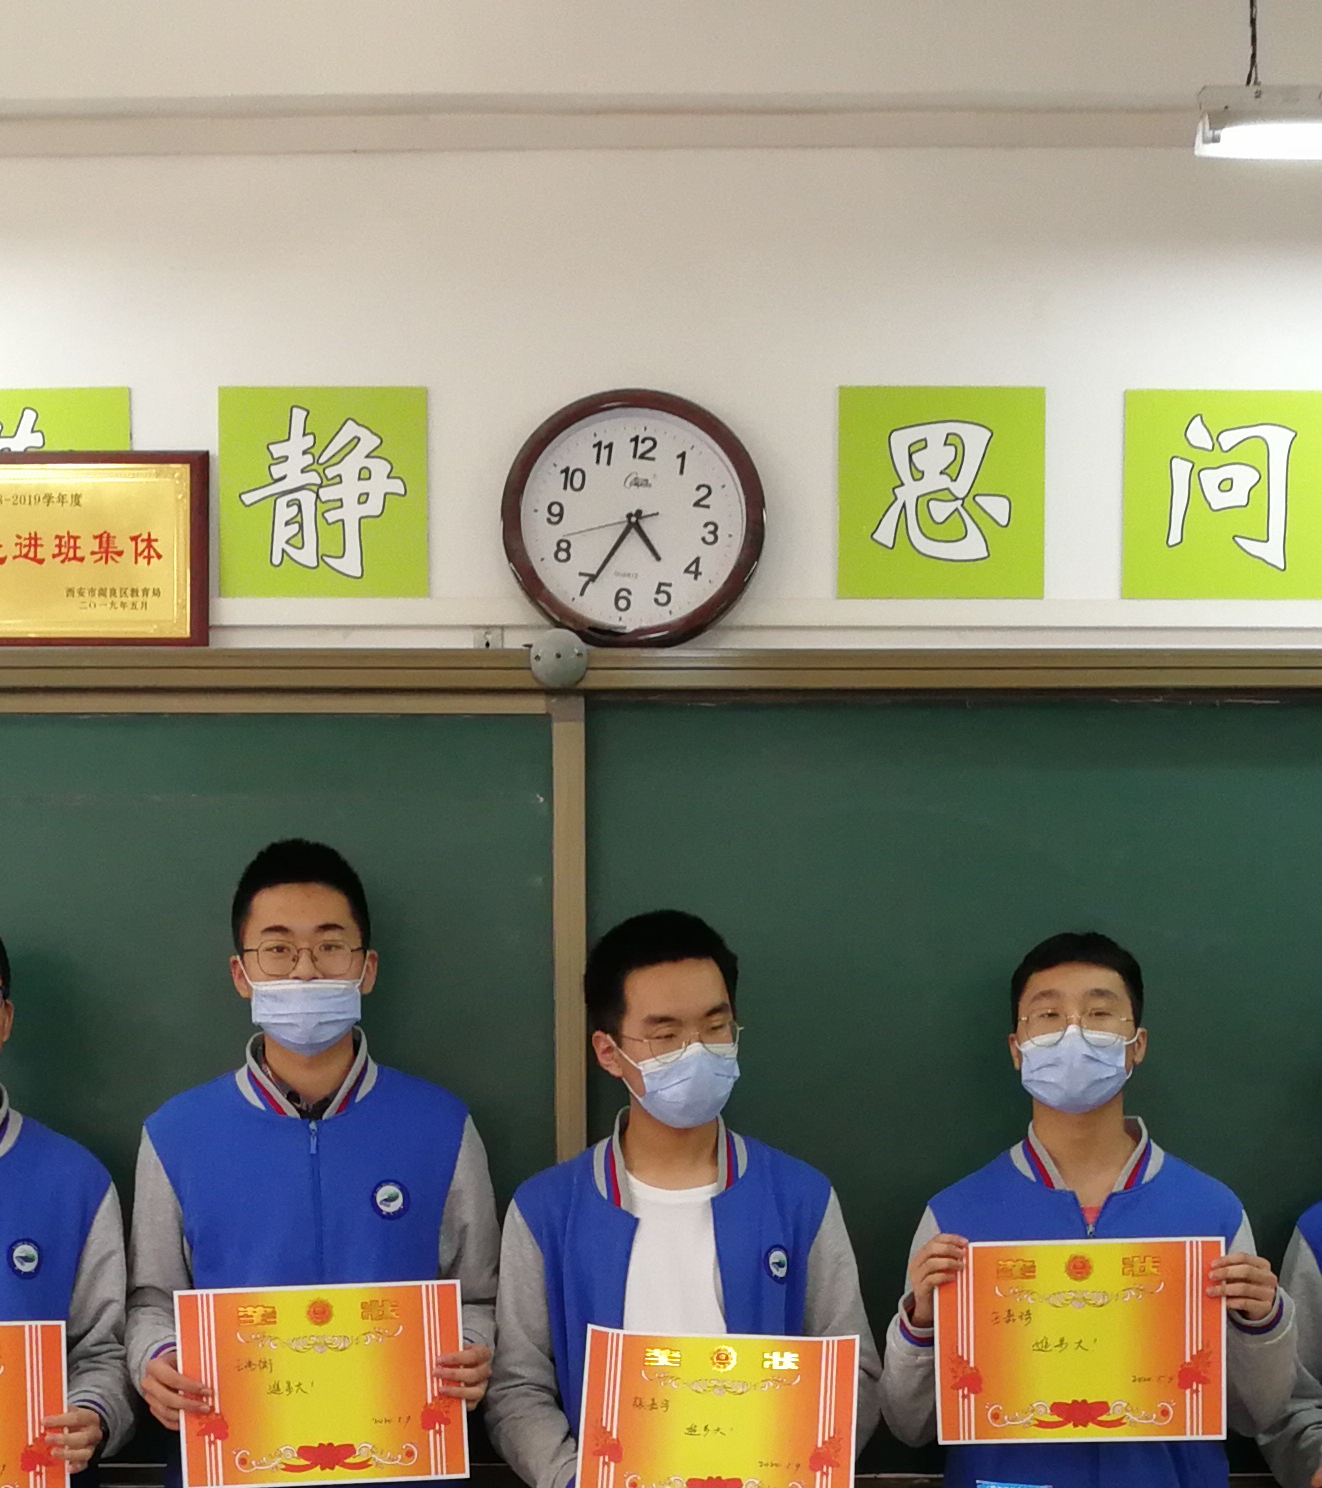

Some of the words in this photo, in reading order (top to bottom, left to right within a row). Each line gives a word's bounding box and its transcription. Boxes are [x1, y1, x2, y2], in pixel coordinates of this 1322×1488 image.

[592, 440, 614, 466] 11
[629, 435, 657, 461] 12
[676, 451, 687, 475] 1
[560, 466, 586, 492] 10
[240, 405, 408, 579] 静
[870, 420, 1011, 562] 思
[1166, 414, 1297, 571] 问
[693, 484, 712, 509] 2
[546, 501, 564, 525] 9
[701, 521, 719, 545] 3
[554, 539, 572, 562] 8
[684, 556, 702, 580] 4
[578, 571, 596, 597] 7
[654, 582, 672, 607] 5
[614, 588, 632, 612] 6
